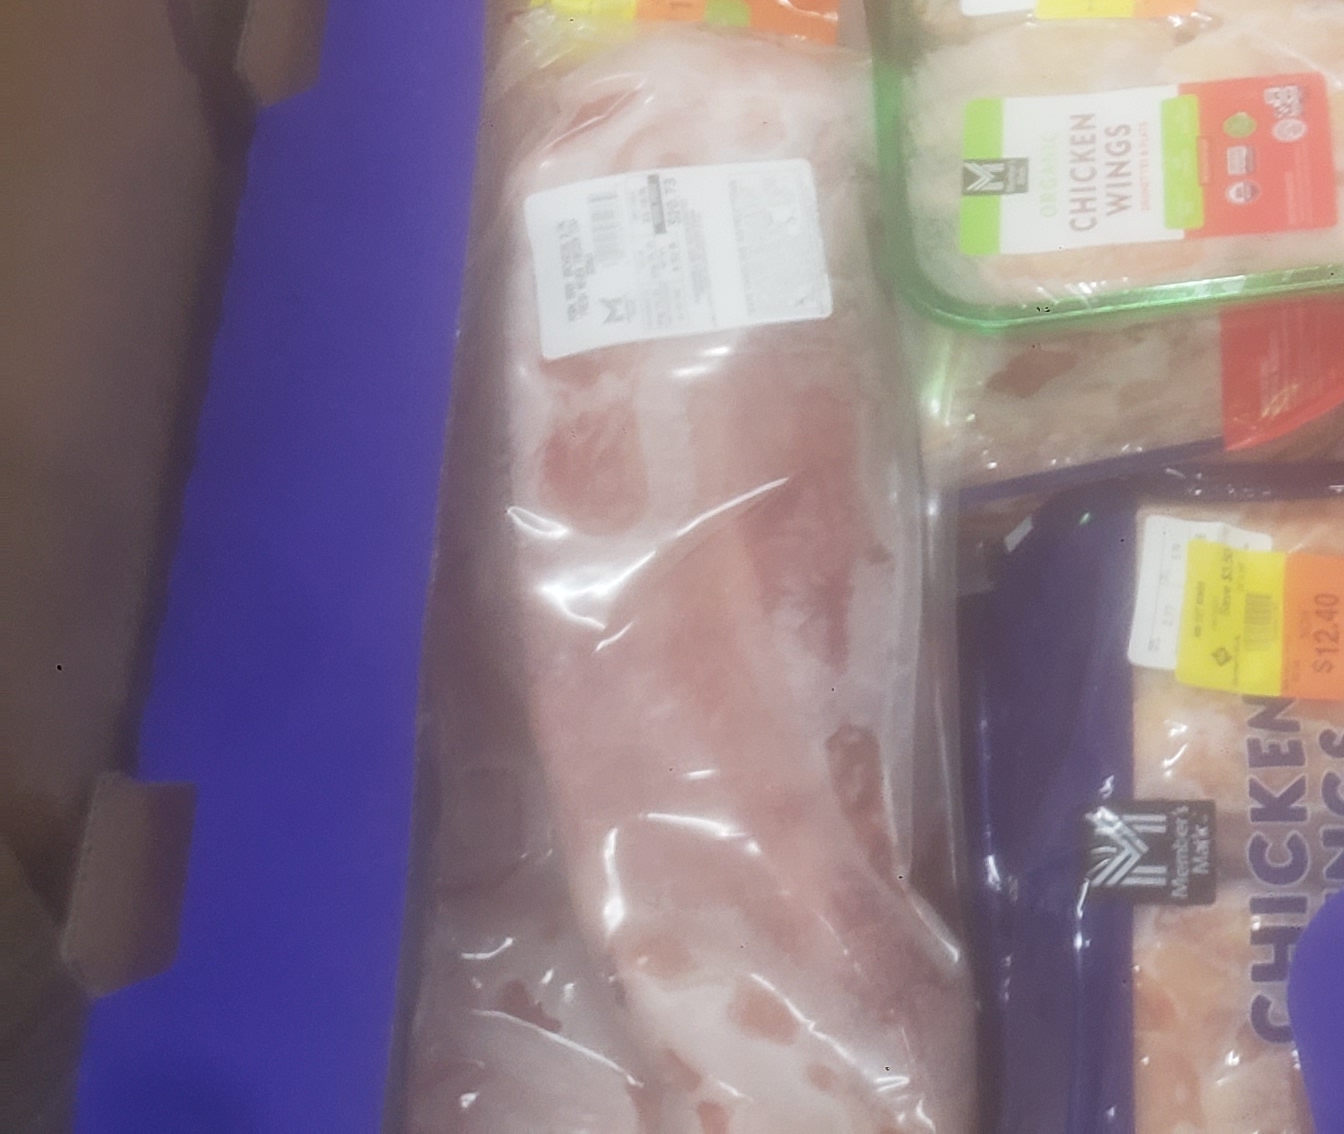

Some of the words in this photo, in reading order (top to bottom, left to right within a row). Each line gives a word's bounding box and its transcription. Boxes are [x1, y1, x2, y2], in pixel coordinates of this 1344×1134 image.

[1069, 113, 1098, 232] CHICKEN
[1105, 123, 1133, 217] WINGS
[1311, 592, 1341, 674] $12.40
[1169, 804, 1190, 900] Member's
[1243, 697, 1308, 1044] CHICKEN
